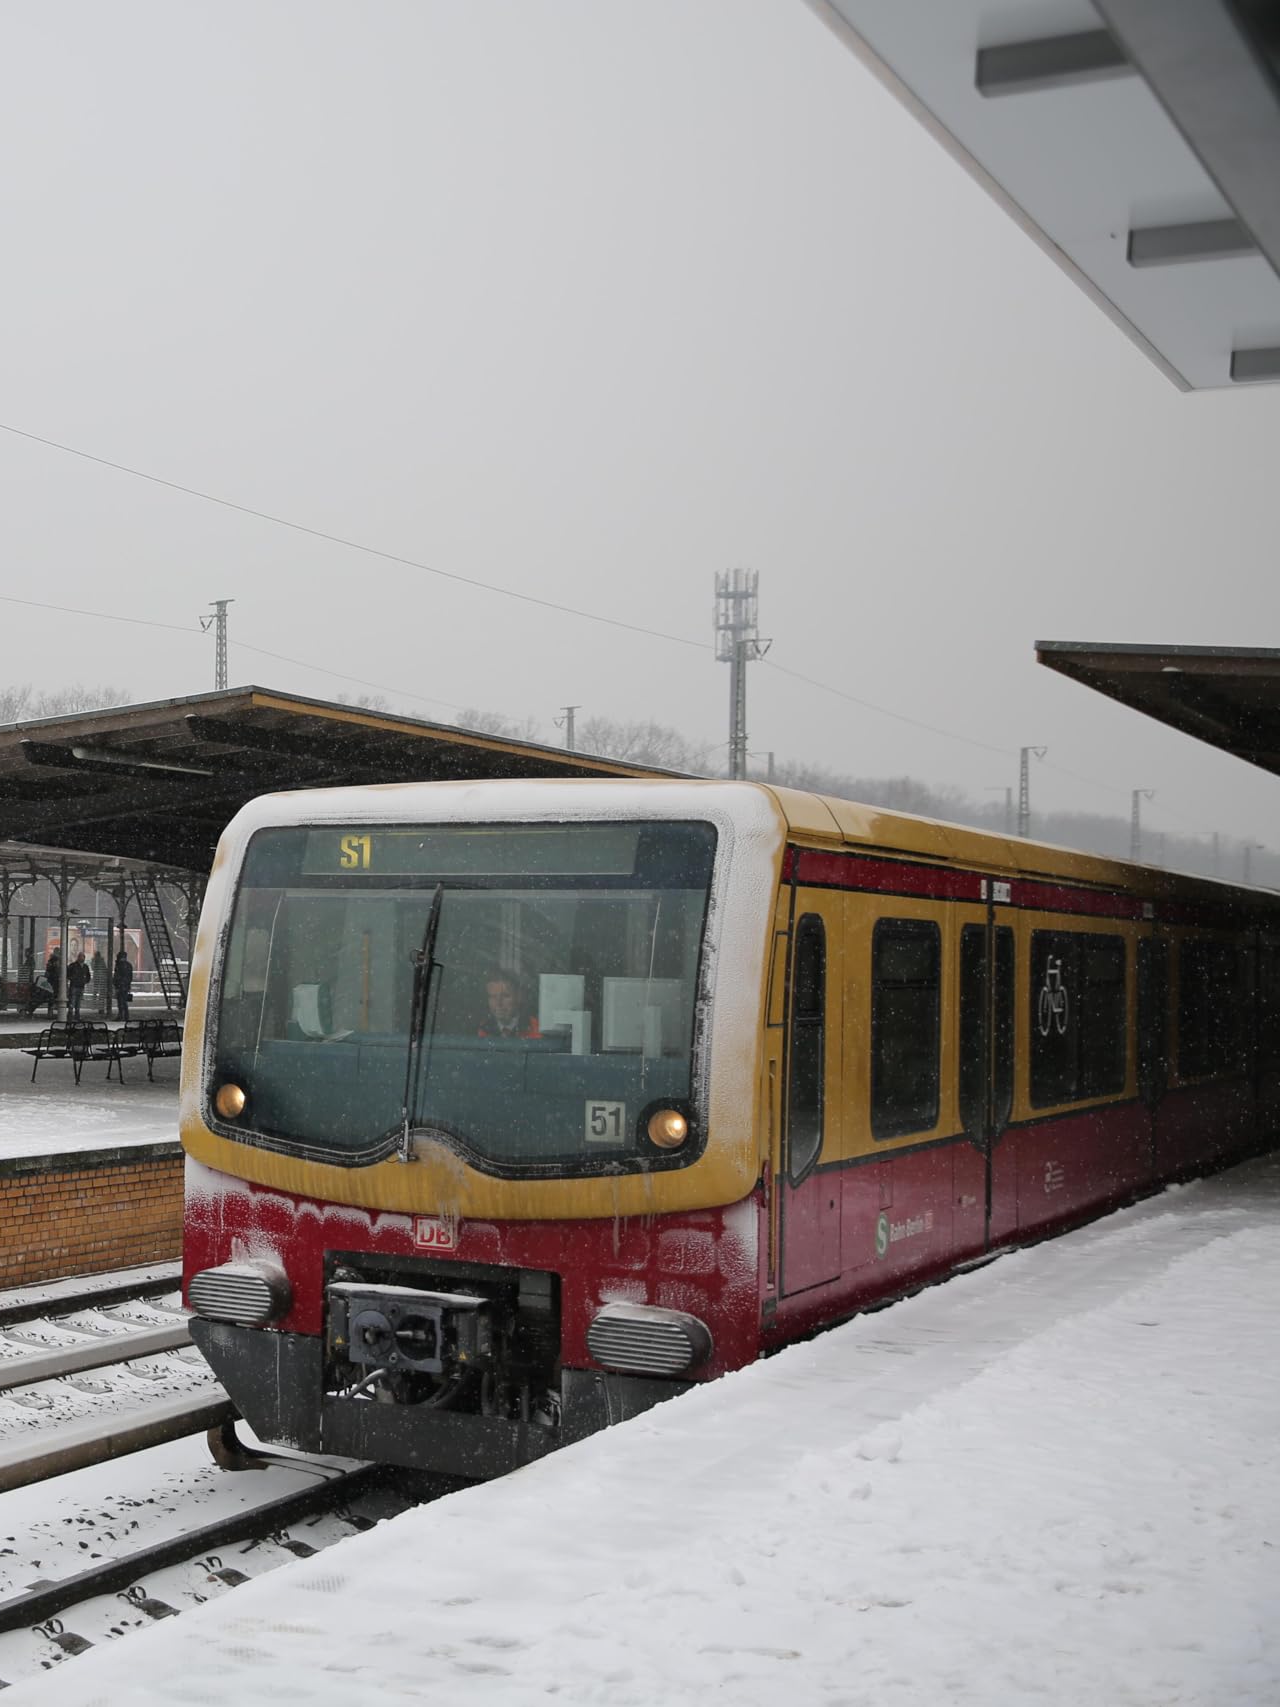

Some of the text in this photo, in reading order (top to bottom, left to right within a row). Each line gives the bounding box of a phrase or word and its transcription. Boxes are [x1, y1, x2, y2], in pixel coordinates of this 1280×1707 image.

[340, 835, 371, 869] S1
[591, 1106, 621, 1137] 51
[420, 1221, 451, 1245] DB
